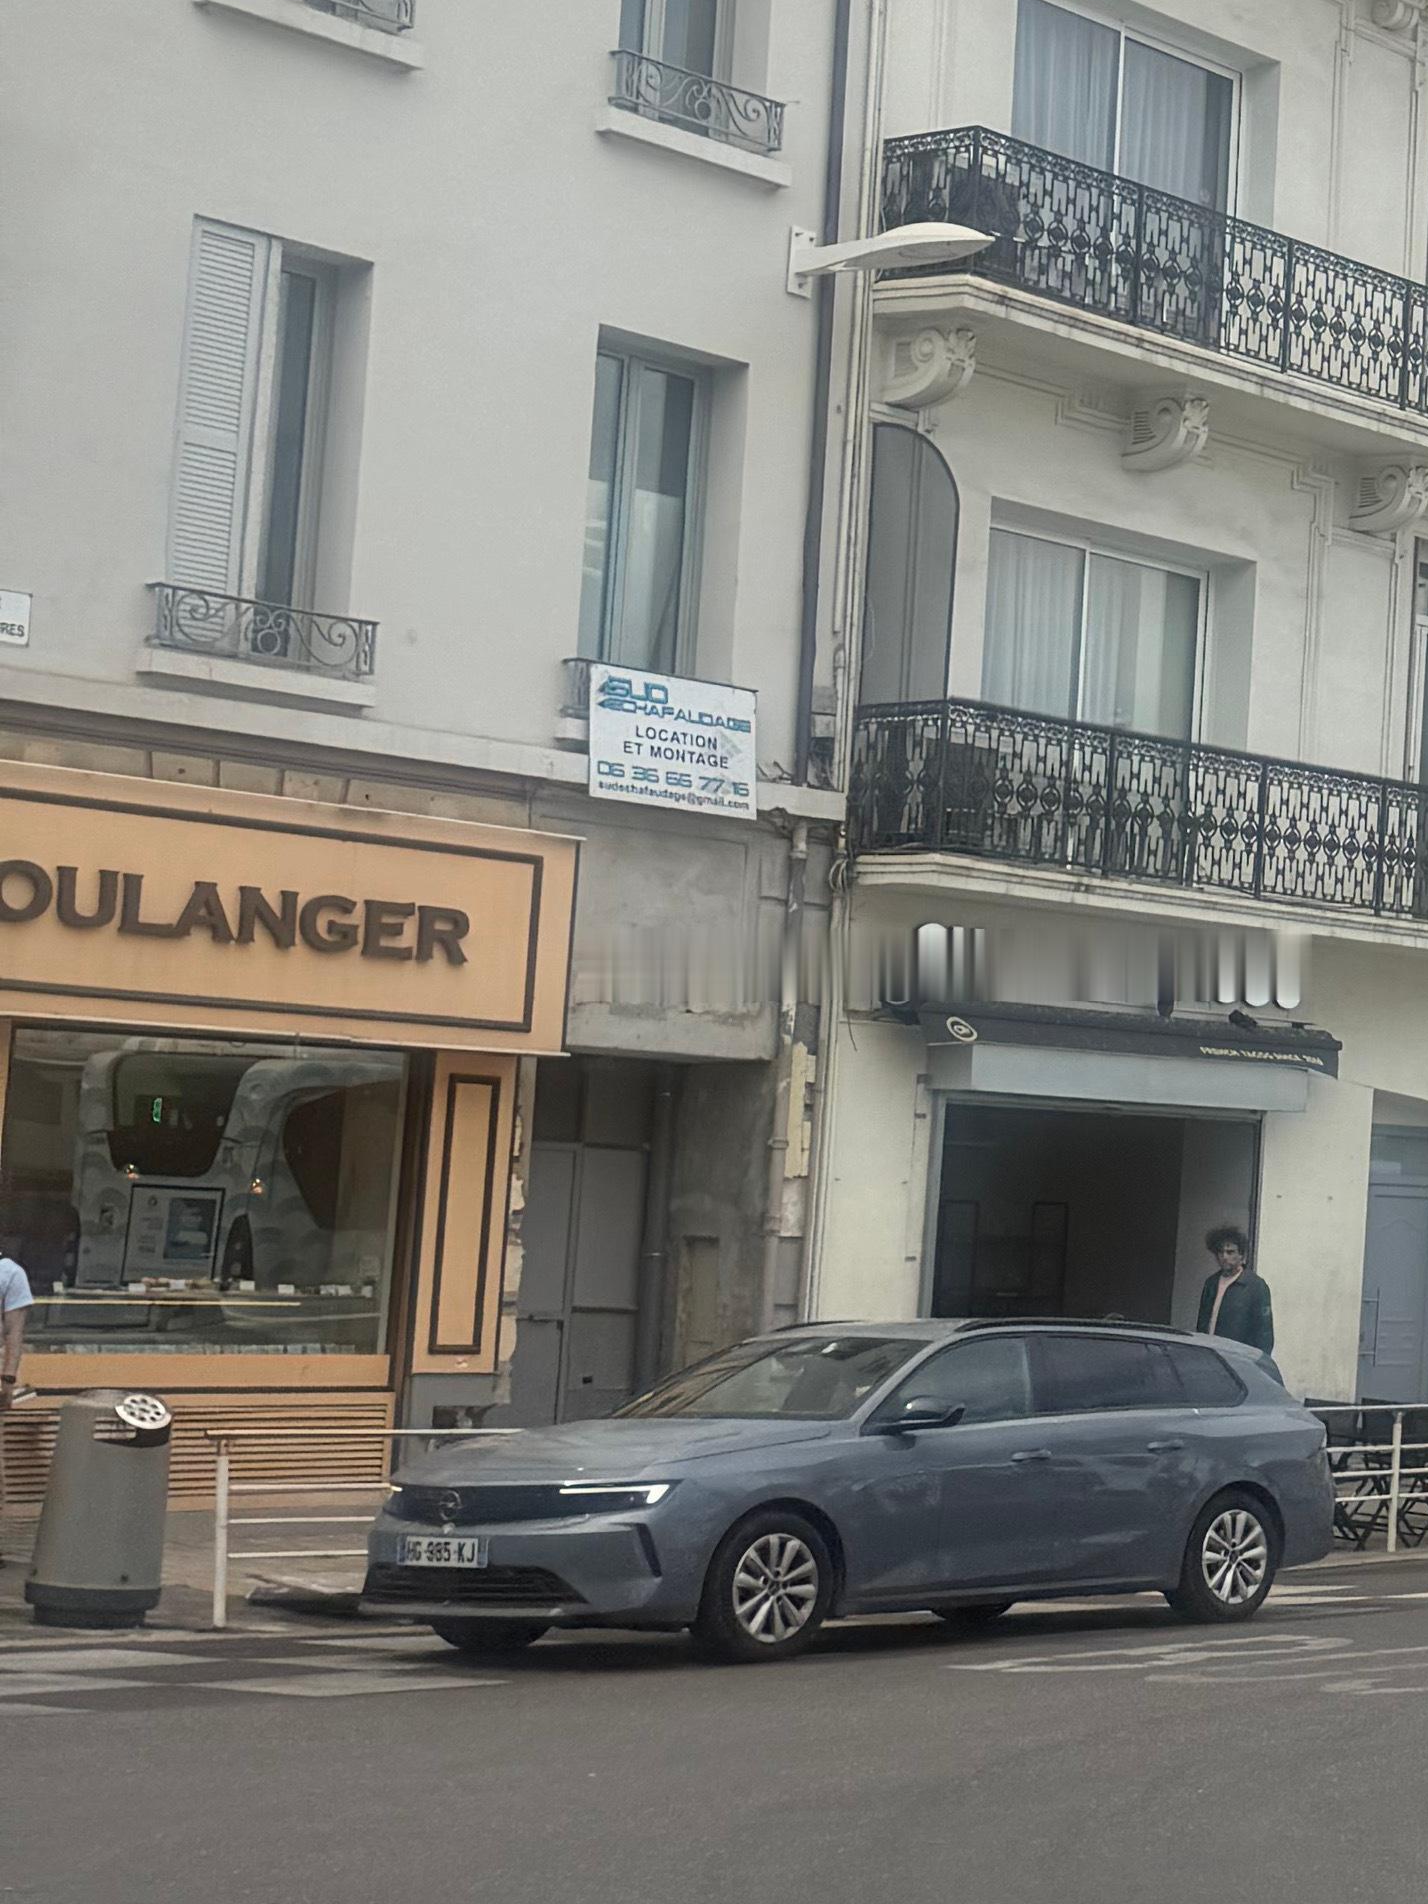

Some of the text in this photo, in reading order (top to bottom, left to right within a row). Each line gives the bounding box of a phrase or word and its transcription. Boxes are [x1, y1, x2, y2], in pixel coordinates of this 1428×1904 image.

[600, 675, 669, 705] SUD
[635, 725, 718, 751] LOCATION
[623, 741, 729, 770] ET MONTAGE
[597, 760, 625, 778] 06
[631, 765, 659, 784] 36
[698, 776, 726, 794] 77
[0, 860, 470, 966] OULANGER
